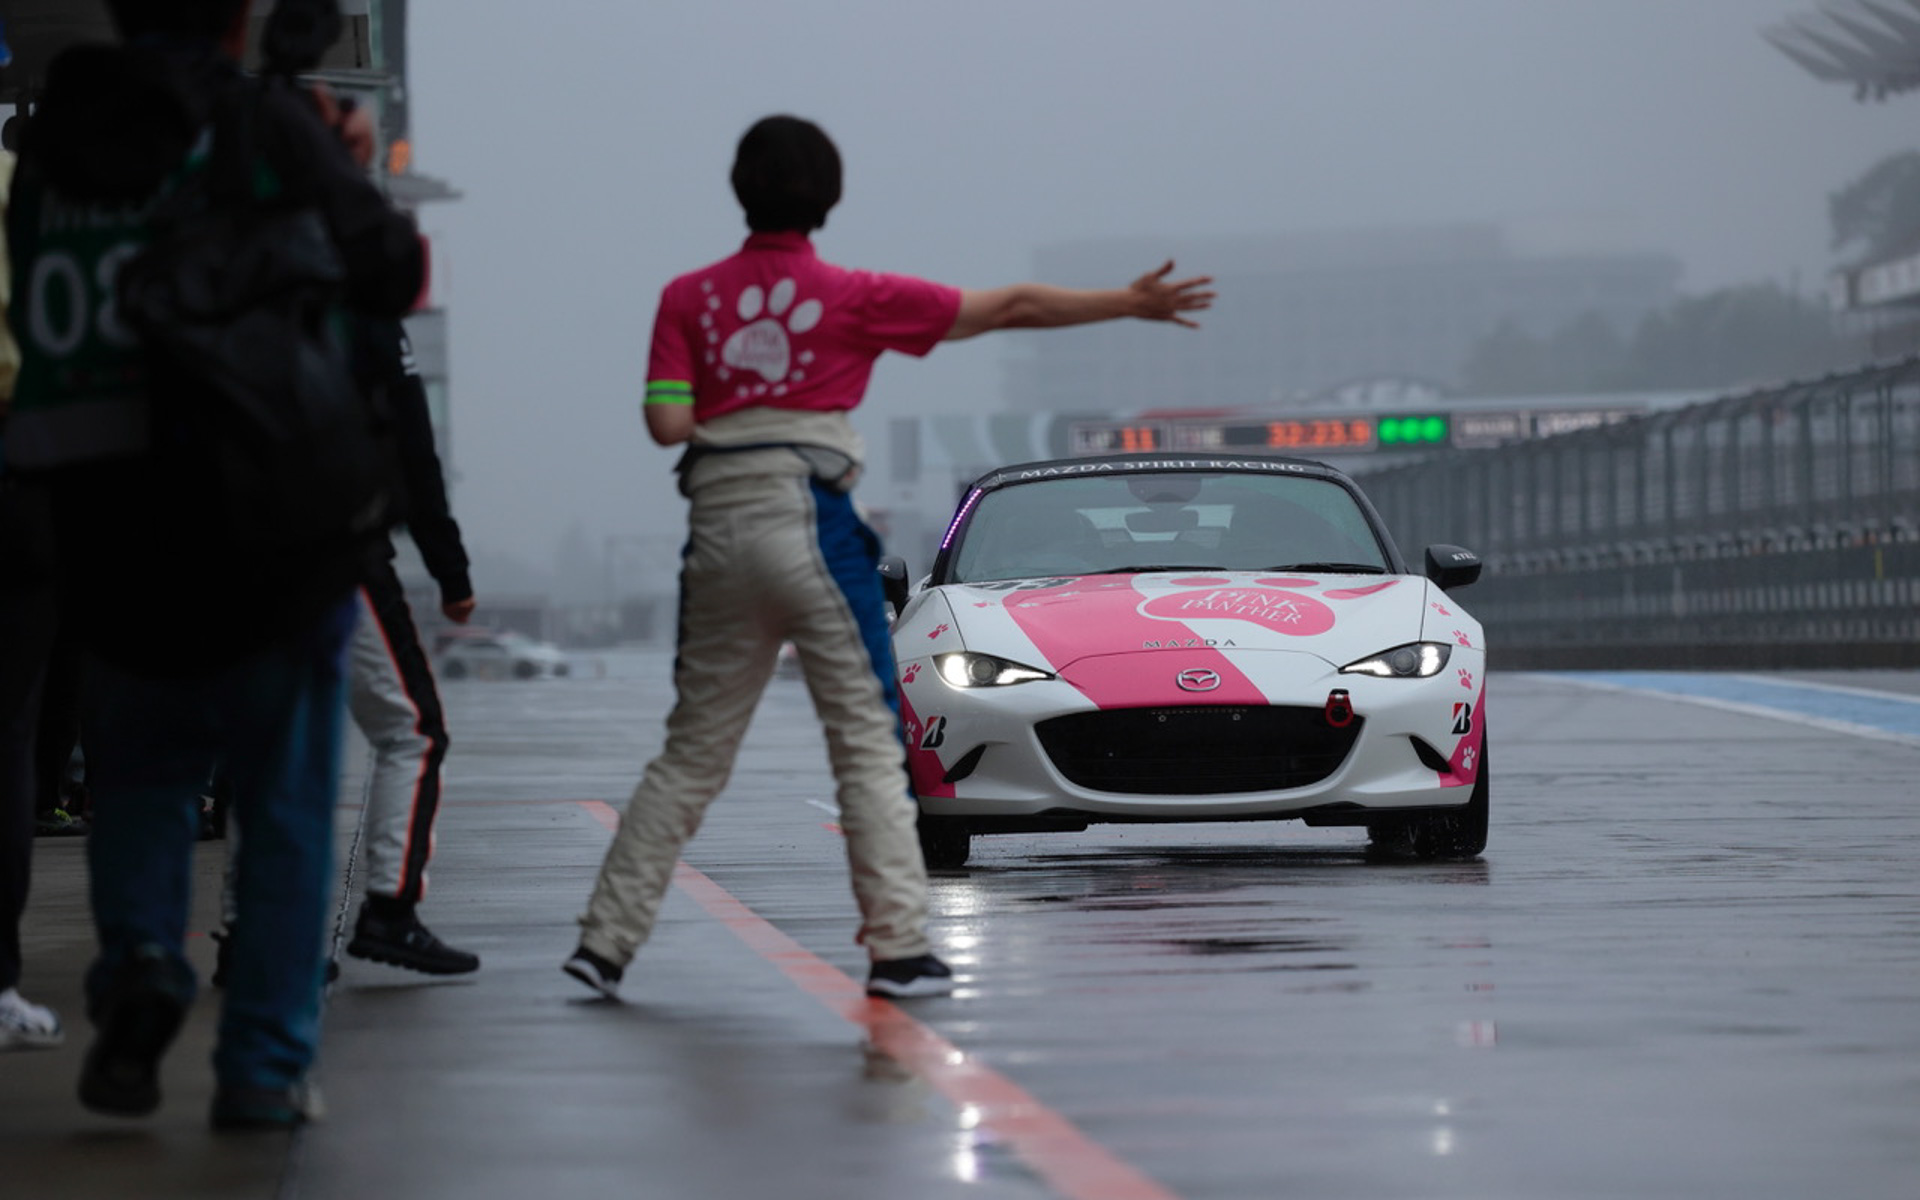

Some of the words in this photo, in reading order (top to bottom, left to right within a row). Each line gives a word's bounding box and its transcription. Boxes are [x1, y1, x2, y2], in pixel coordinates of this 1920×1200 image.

[1020, 462, 1114, 479] MAZDA
[1124, 459, 1197, 469] SPIRIT
[1210, 460, 1304, 472] RACING
[1179, 598, 1303, 625] PANTHER
[1203, 590, 1311, 614] PINK
[1142, 638, 1238, 648] MAZDA
